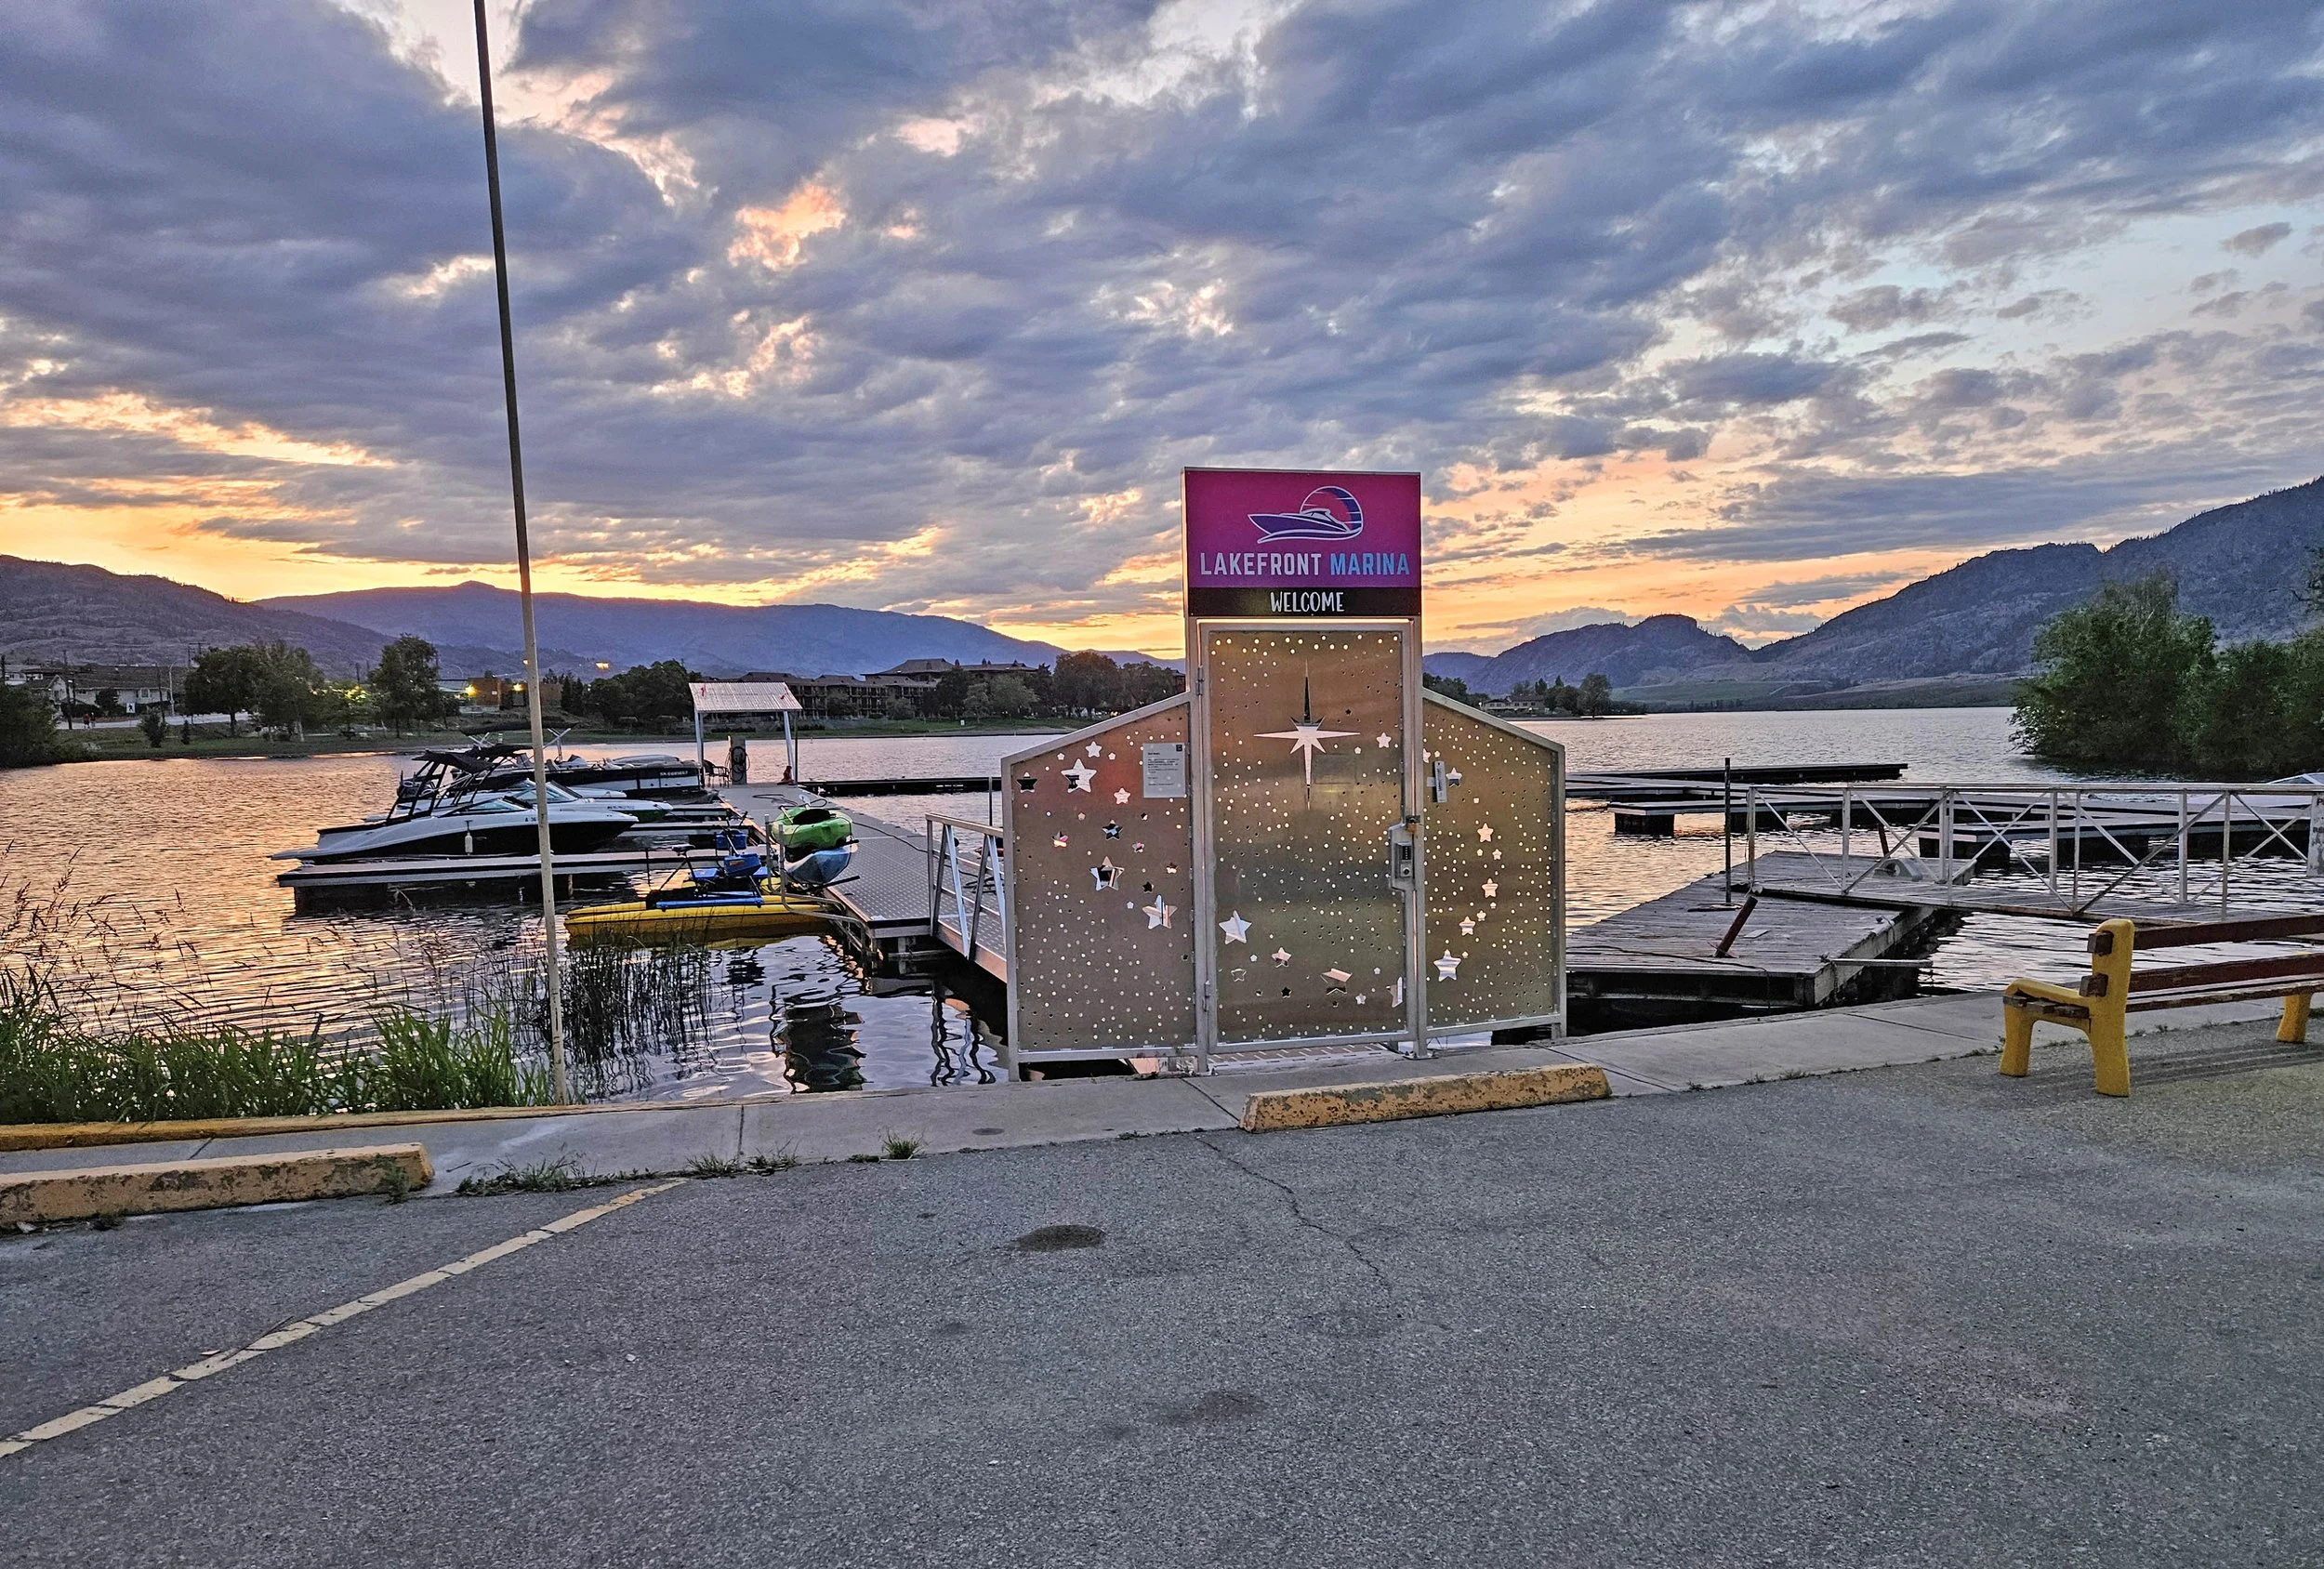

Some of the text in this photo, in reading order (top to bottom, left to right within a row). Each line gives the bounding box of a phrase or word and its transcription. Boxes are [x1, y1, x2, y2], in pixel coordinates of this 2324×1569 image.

[1200, 552, 1410, 575] LAKEFRONT MARINA
[1270, 591, 1345, 613] WELCOME
